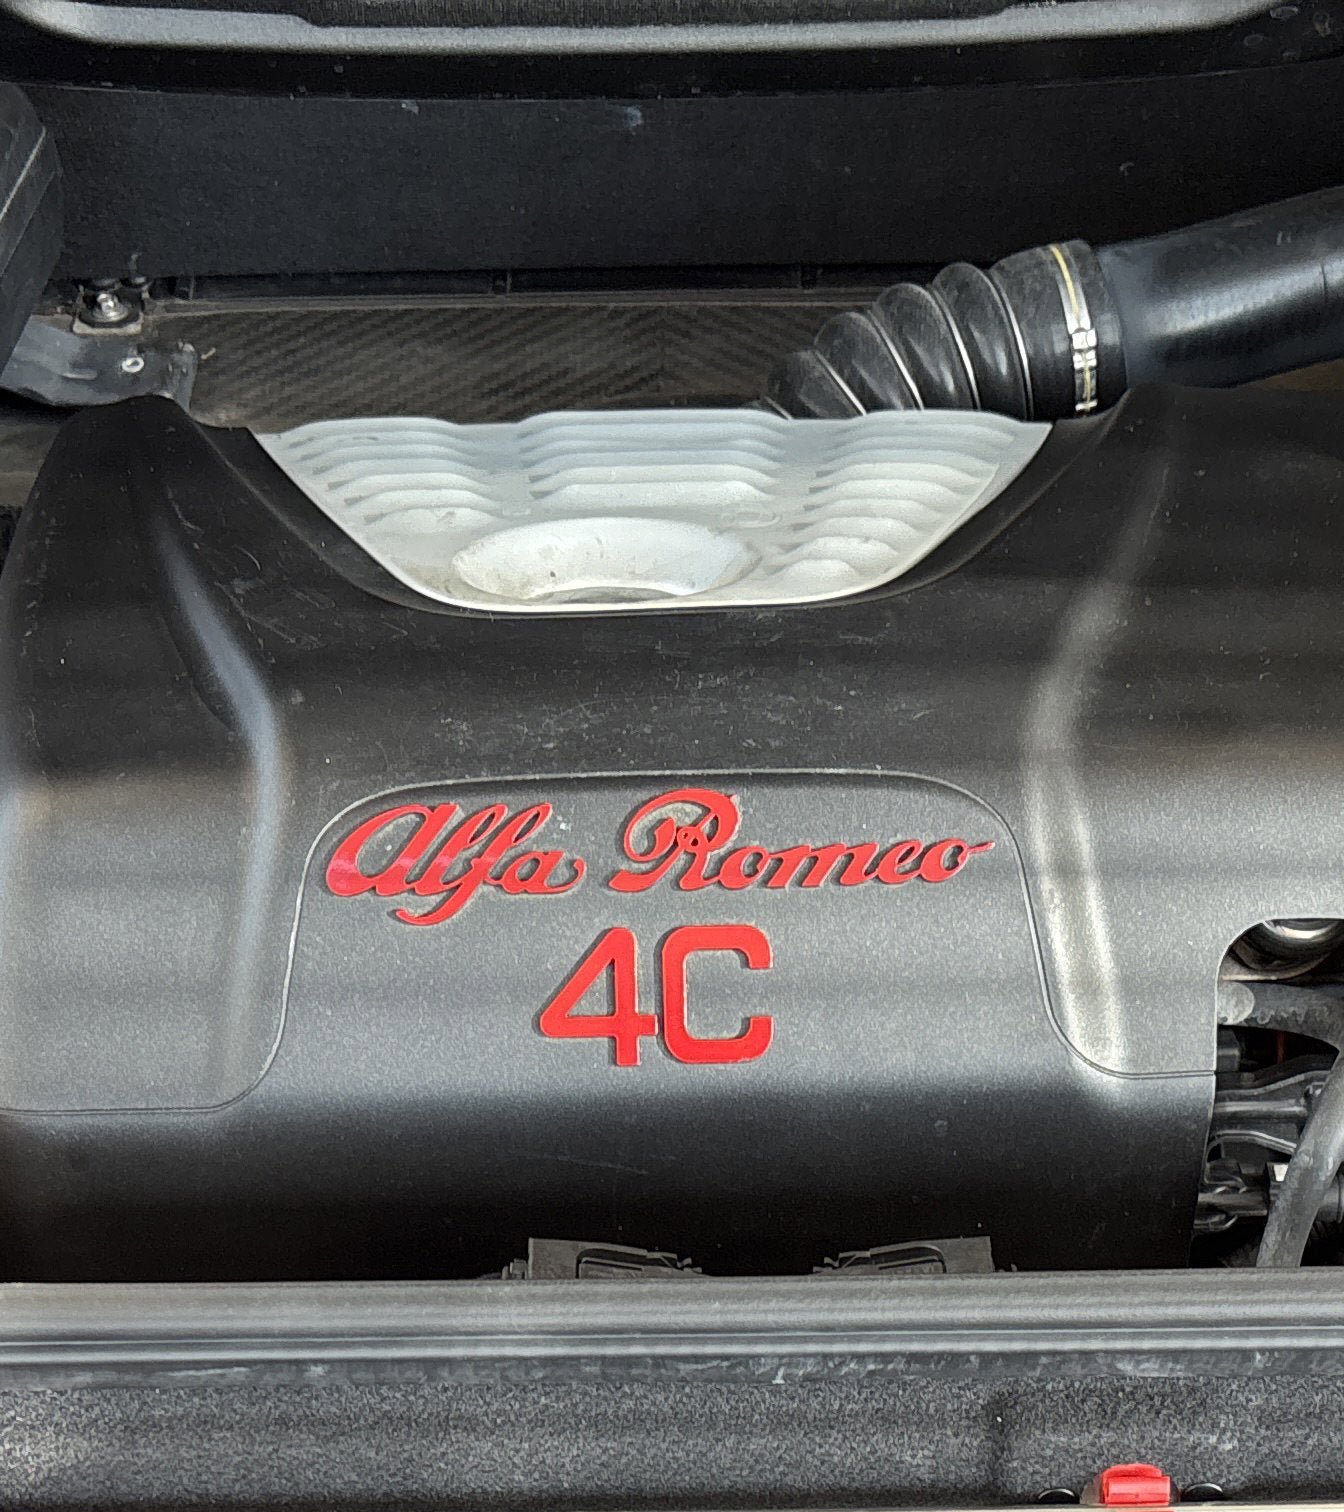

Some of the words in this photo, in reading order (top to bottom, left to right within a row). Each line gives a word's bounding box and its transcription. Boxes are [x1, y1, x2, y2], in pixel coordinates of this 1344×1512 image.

[325, 801, 586, 926] Alfa
[608, 787, 996, 892] Romeo
[538, 923, 775, 1067] 4C
